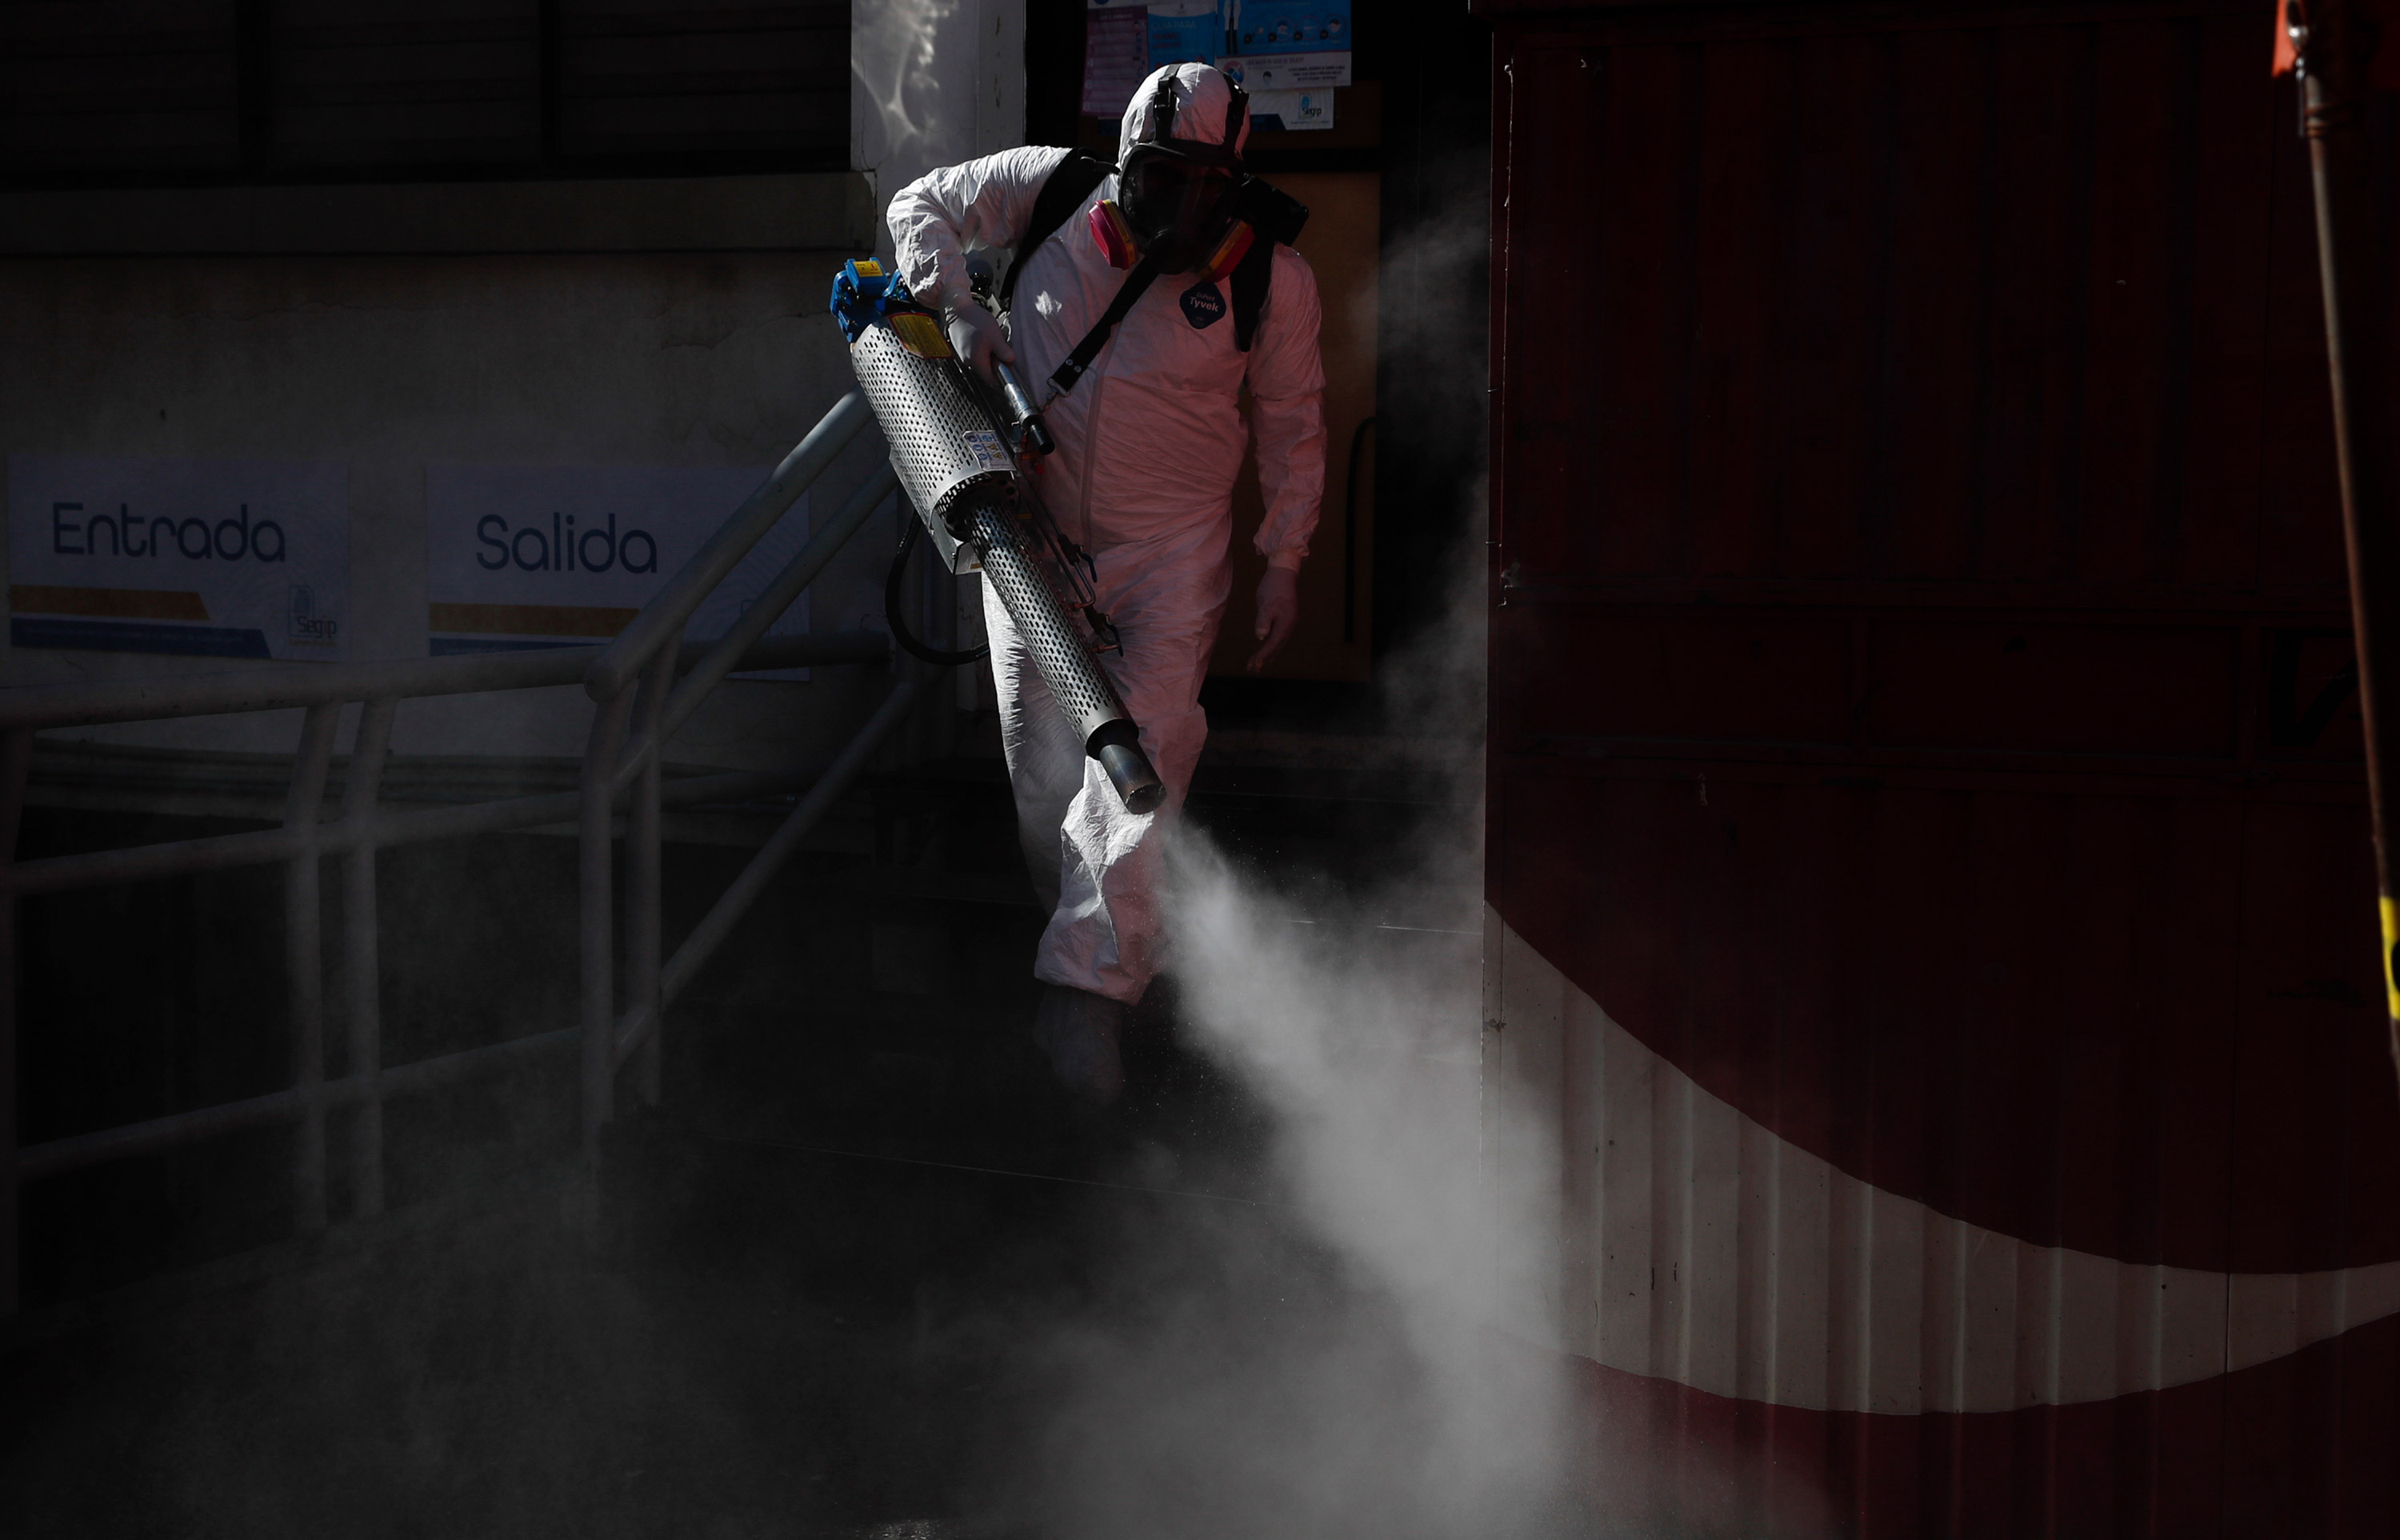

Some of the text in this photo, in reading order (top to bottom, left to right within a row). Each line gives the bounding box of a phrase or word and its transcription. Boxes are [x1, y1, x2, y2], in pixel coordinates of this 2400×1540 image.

[1189, 296, 1219, 313] Tyvek
[52, 501, 286, 562] Entrada
[475, 511, 658, 574] Salida
